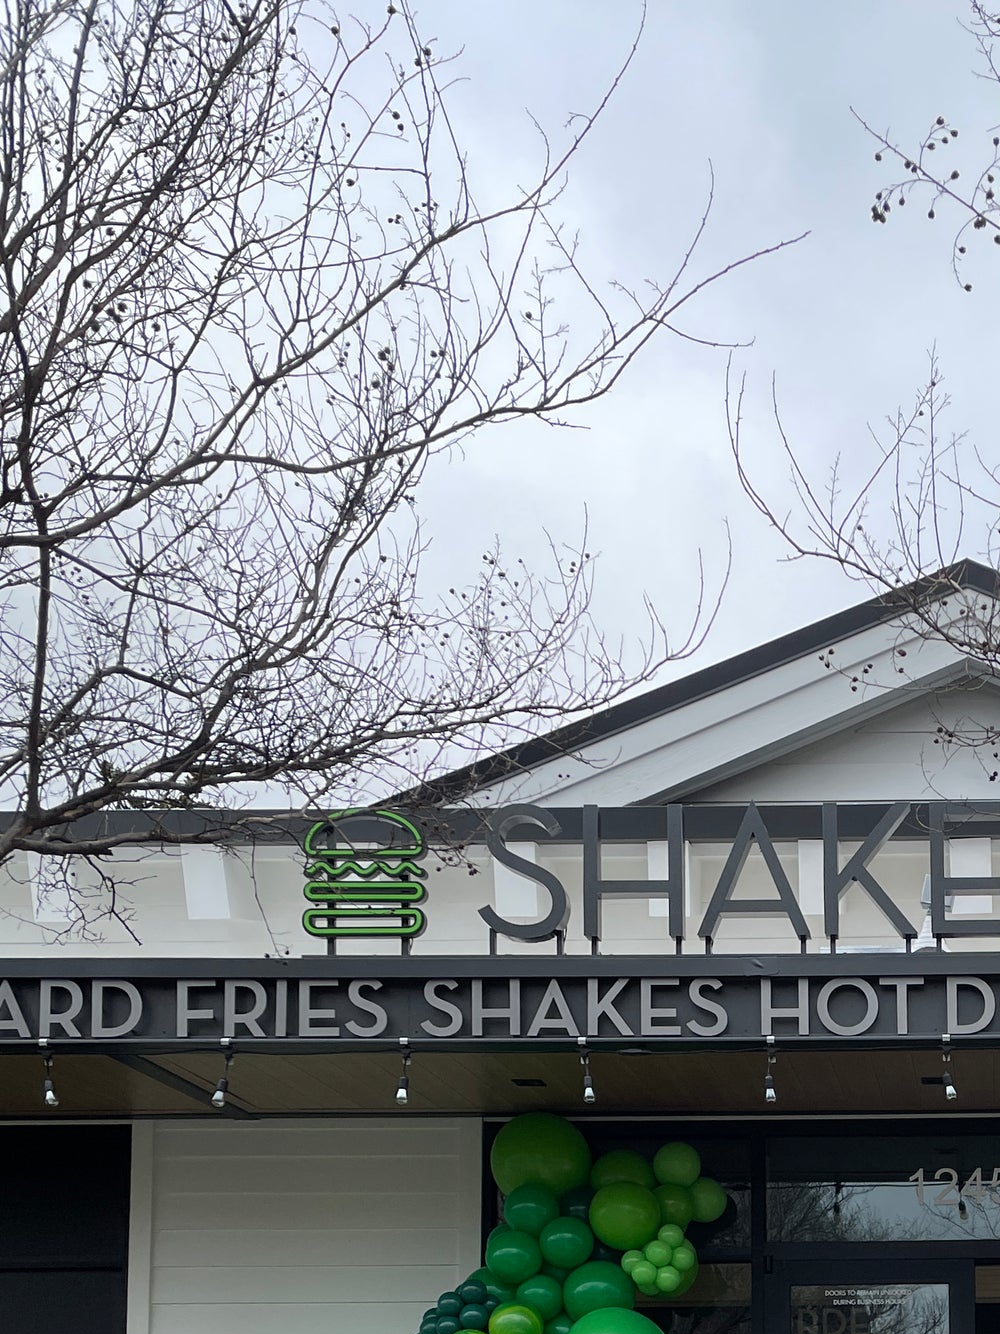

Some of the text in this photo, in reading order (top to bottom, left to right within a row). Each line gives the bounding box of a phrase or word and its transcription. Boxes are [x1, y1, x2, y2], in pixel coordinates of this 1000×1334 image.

[176, 978, 389, 1038] FRIES
[421, 977, 729, 1037] SHAKES
[760, 976, 924, 1035] HOT
[832, 1298, 857, 1306] DURING
